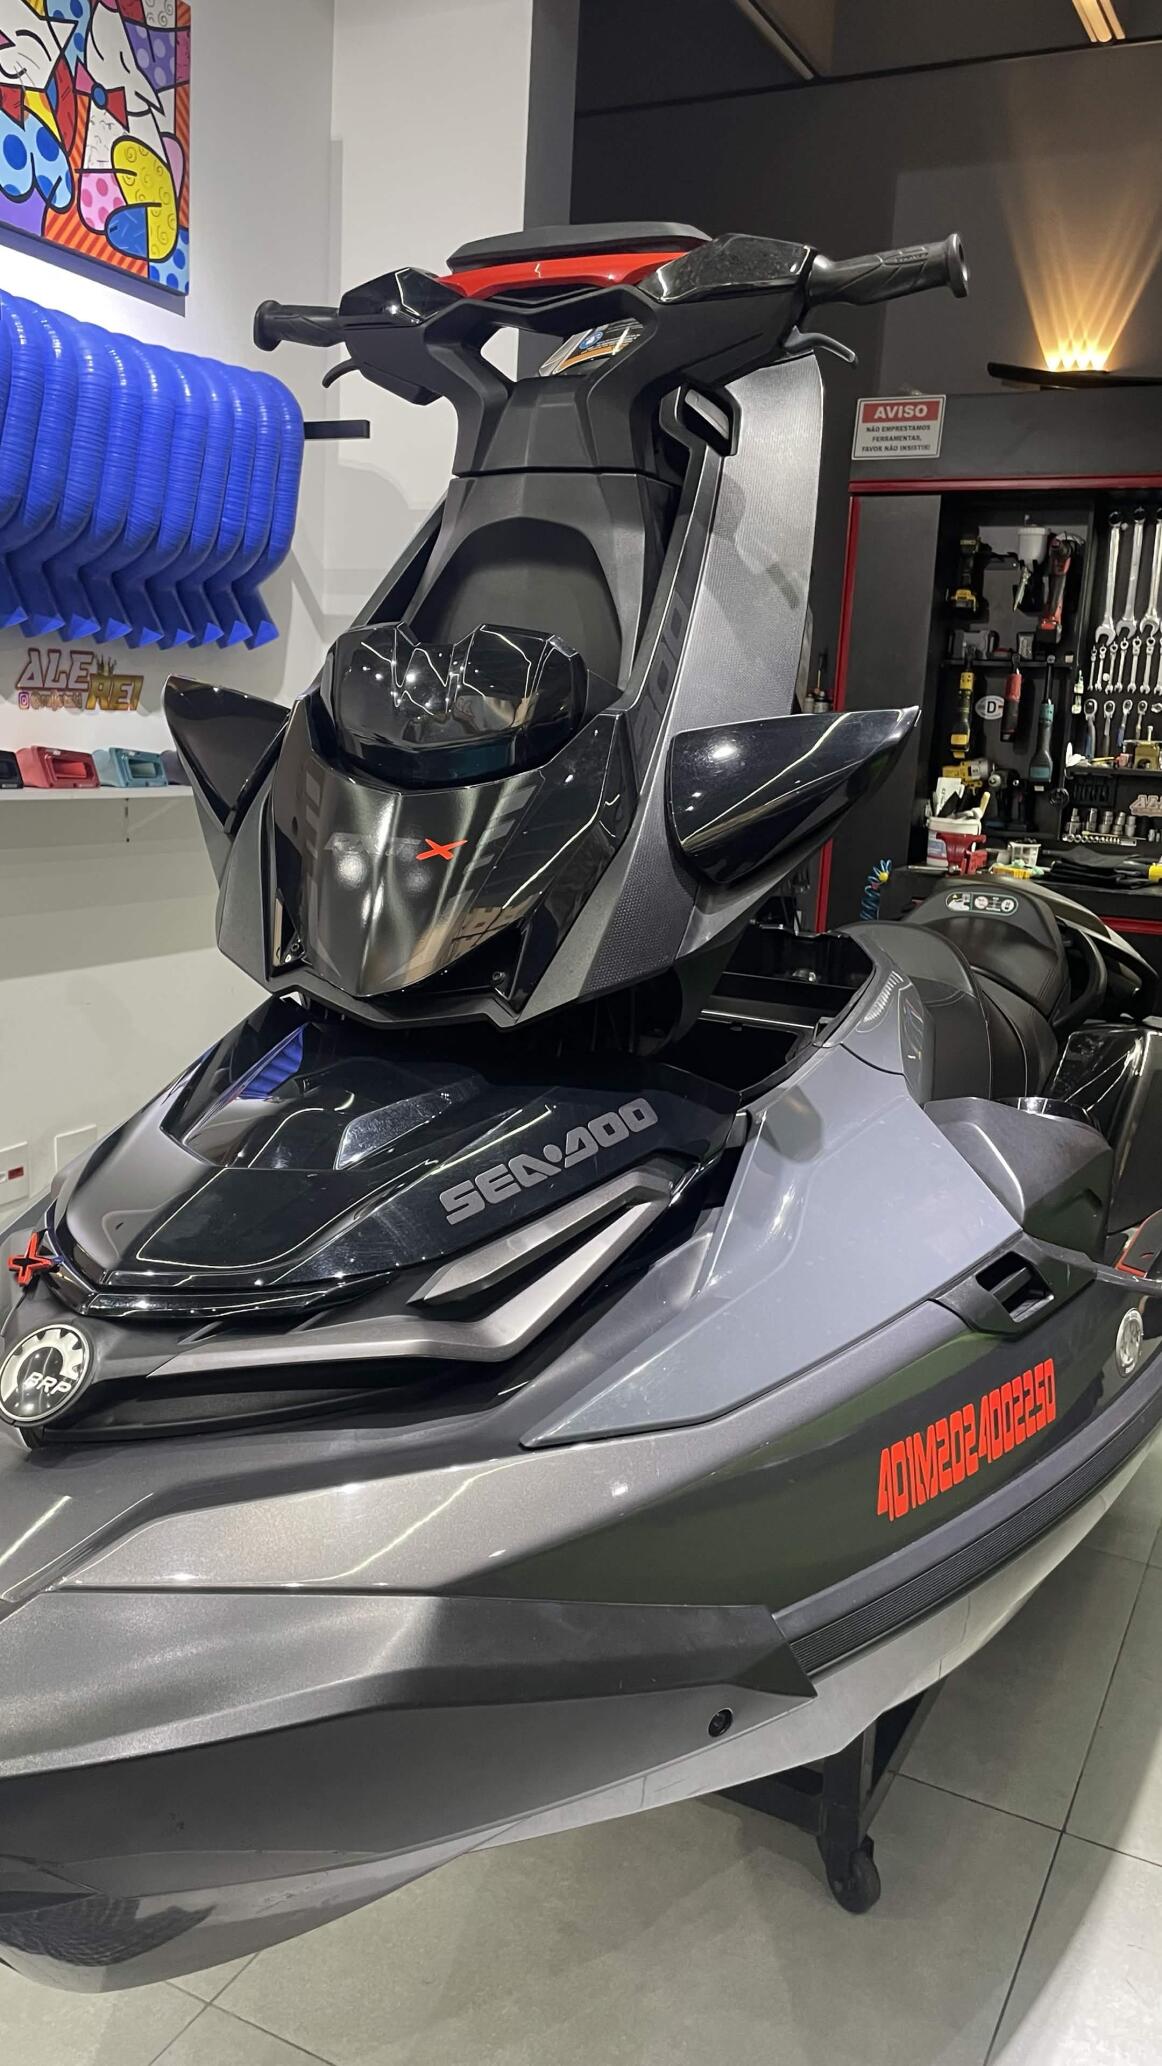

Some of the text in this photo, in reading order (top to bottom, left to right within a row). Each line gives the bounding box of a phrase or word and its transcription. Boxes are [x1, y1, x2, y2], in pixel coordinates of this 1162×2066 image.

[874, 404, 928, 419] AVISO
[866, 424, 931, 433] NÃO EMPRESTAMOS
[884, 444, 898, 452] NÃO
[16, 648, 95, 691] ALE
[86, 674, 144, 711] REI
[986, 701, 997, 713] D
[23, 1371, 73, 1395] BRP
[877, 1357, 1056, 1522] 401M2024002250
